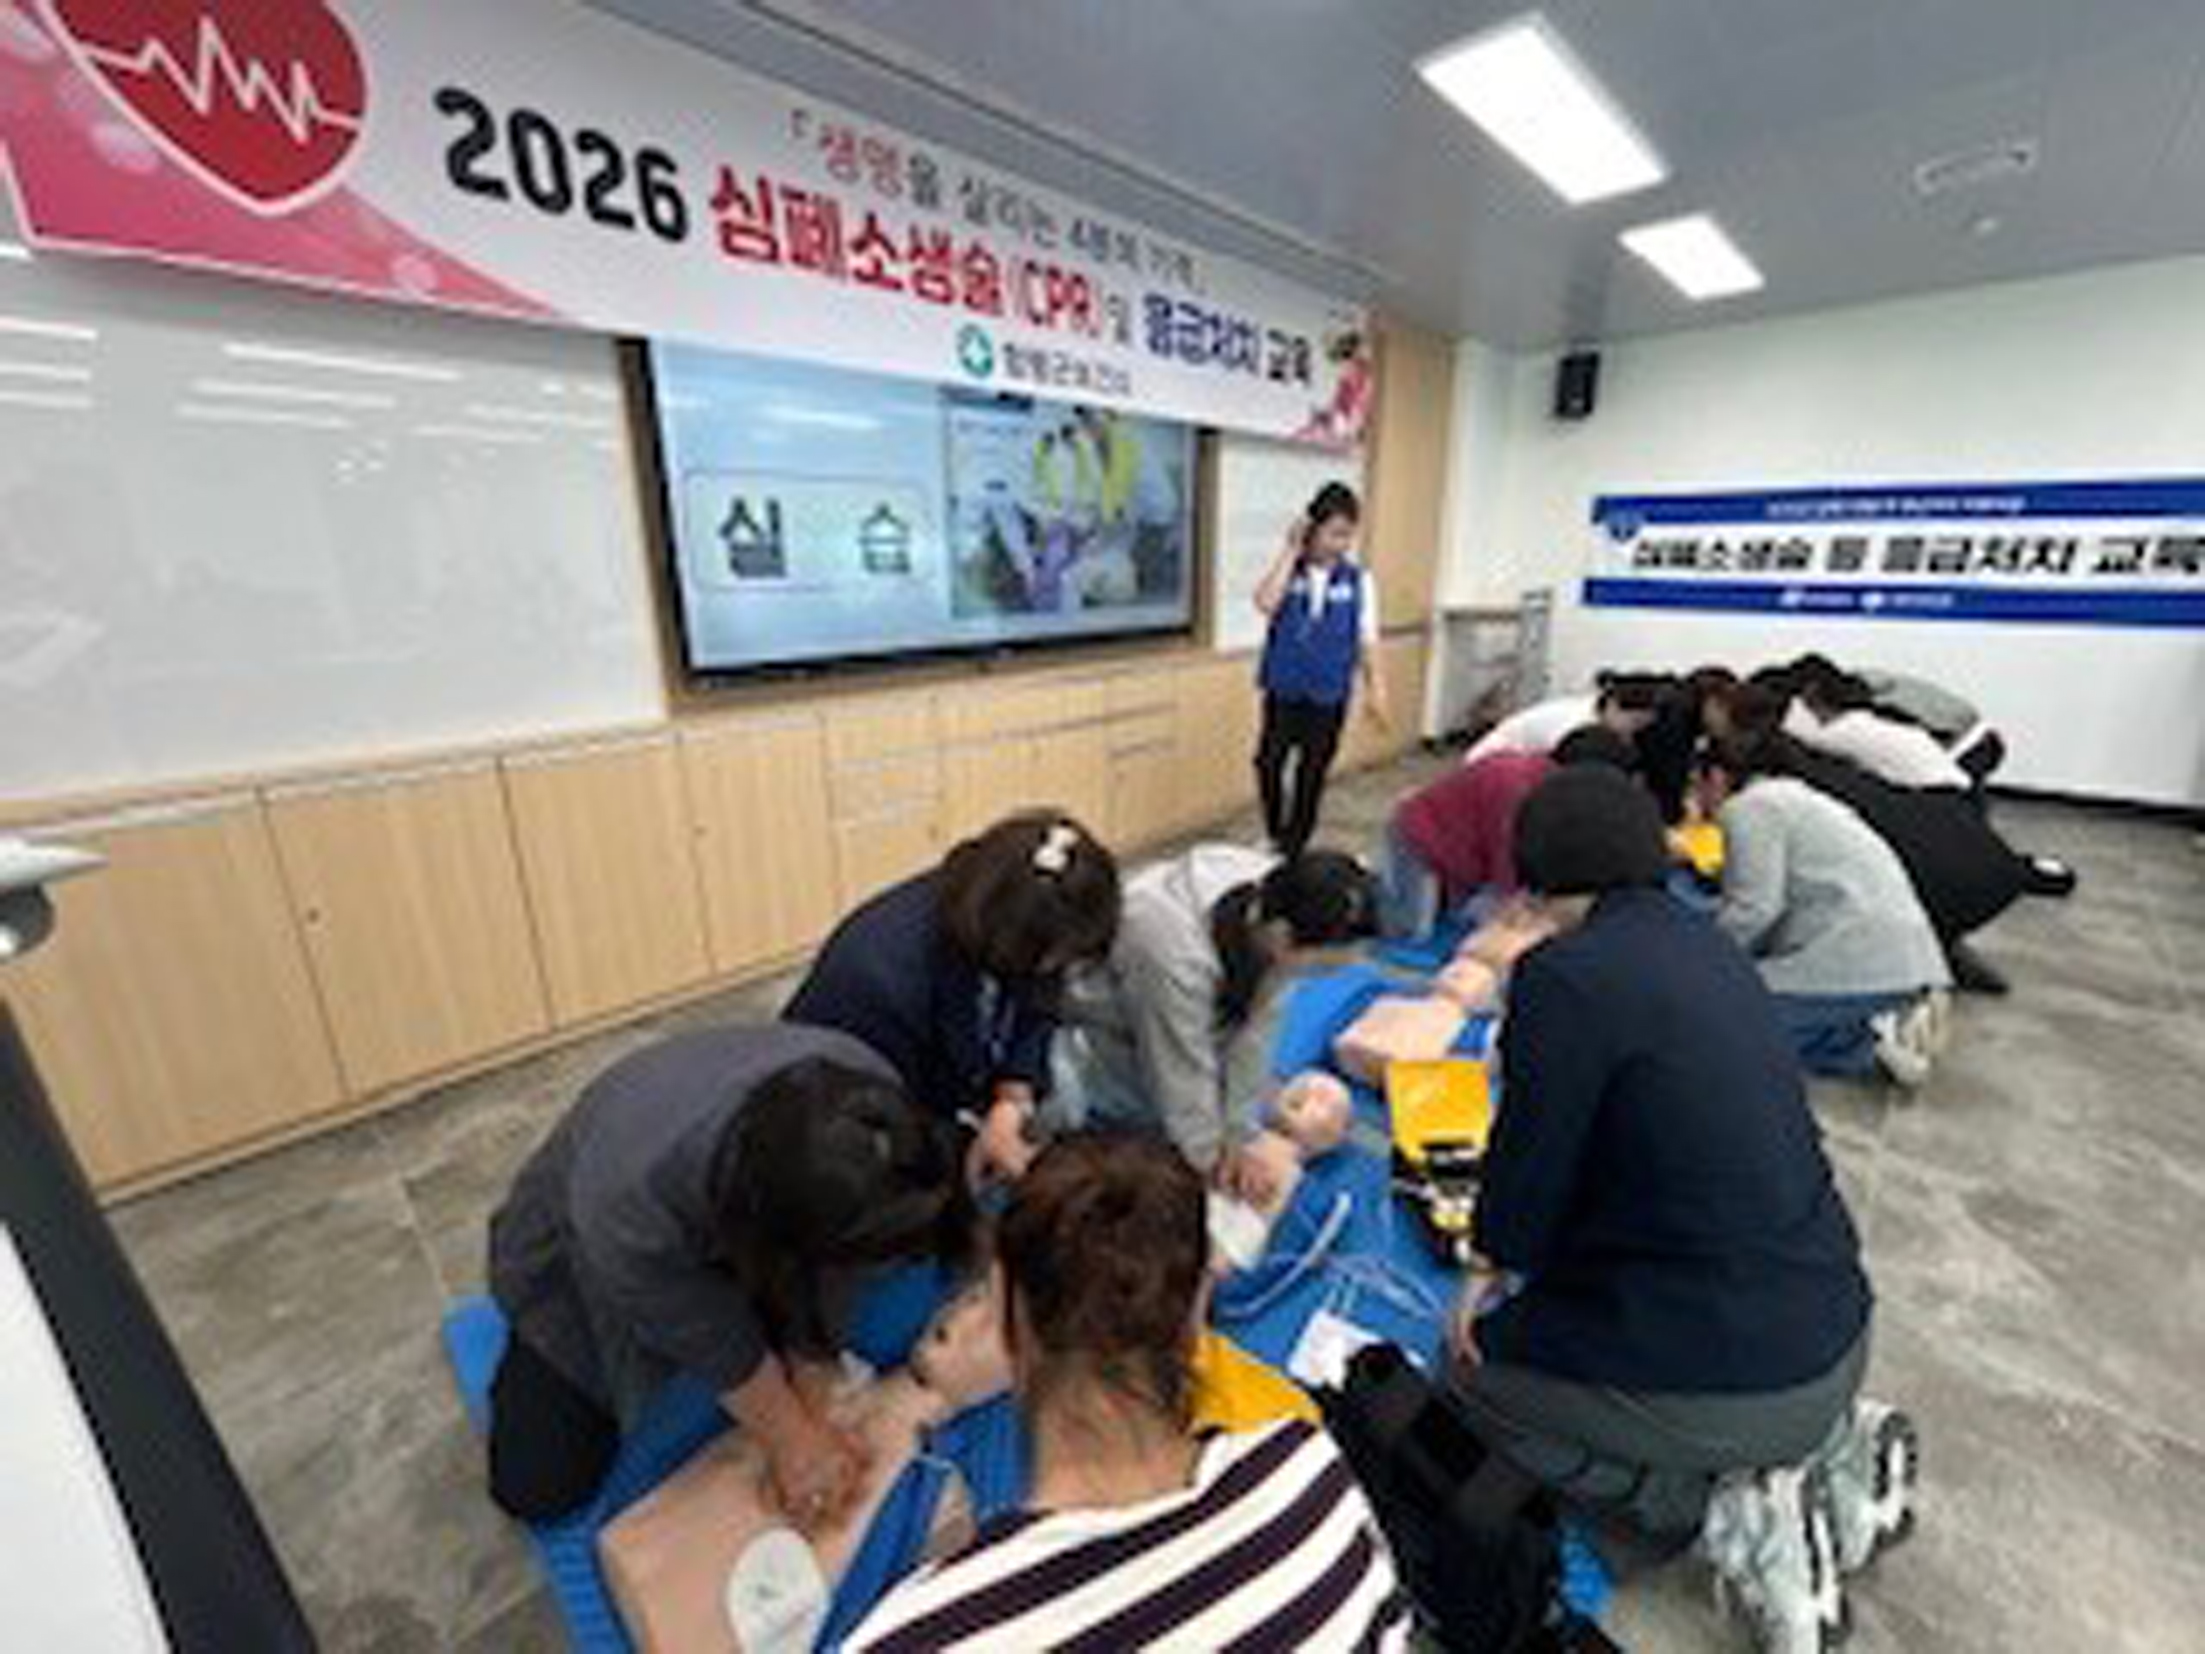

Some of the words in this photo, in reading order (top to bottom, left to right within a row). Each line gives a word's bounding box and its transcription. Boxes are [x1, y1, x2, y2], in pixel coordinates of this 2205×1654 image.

[433, 87, 689, 243] 2026
[1144, 292, 1260, 375] 응급처치
[1267, 328, 1309, 384] 교육
